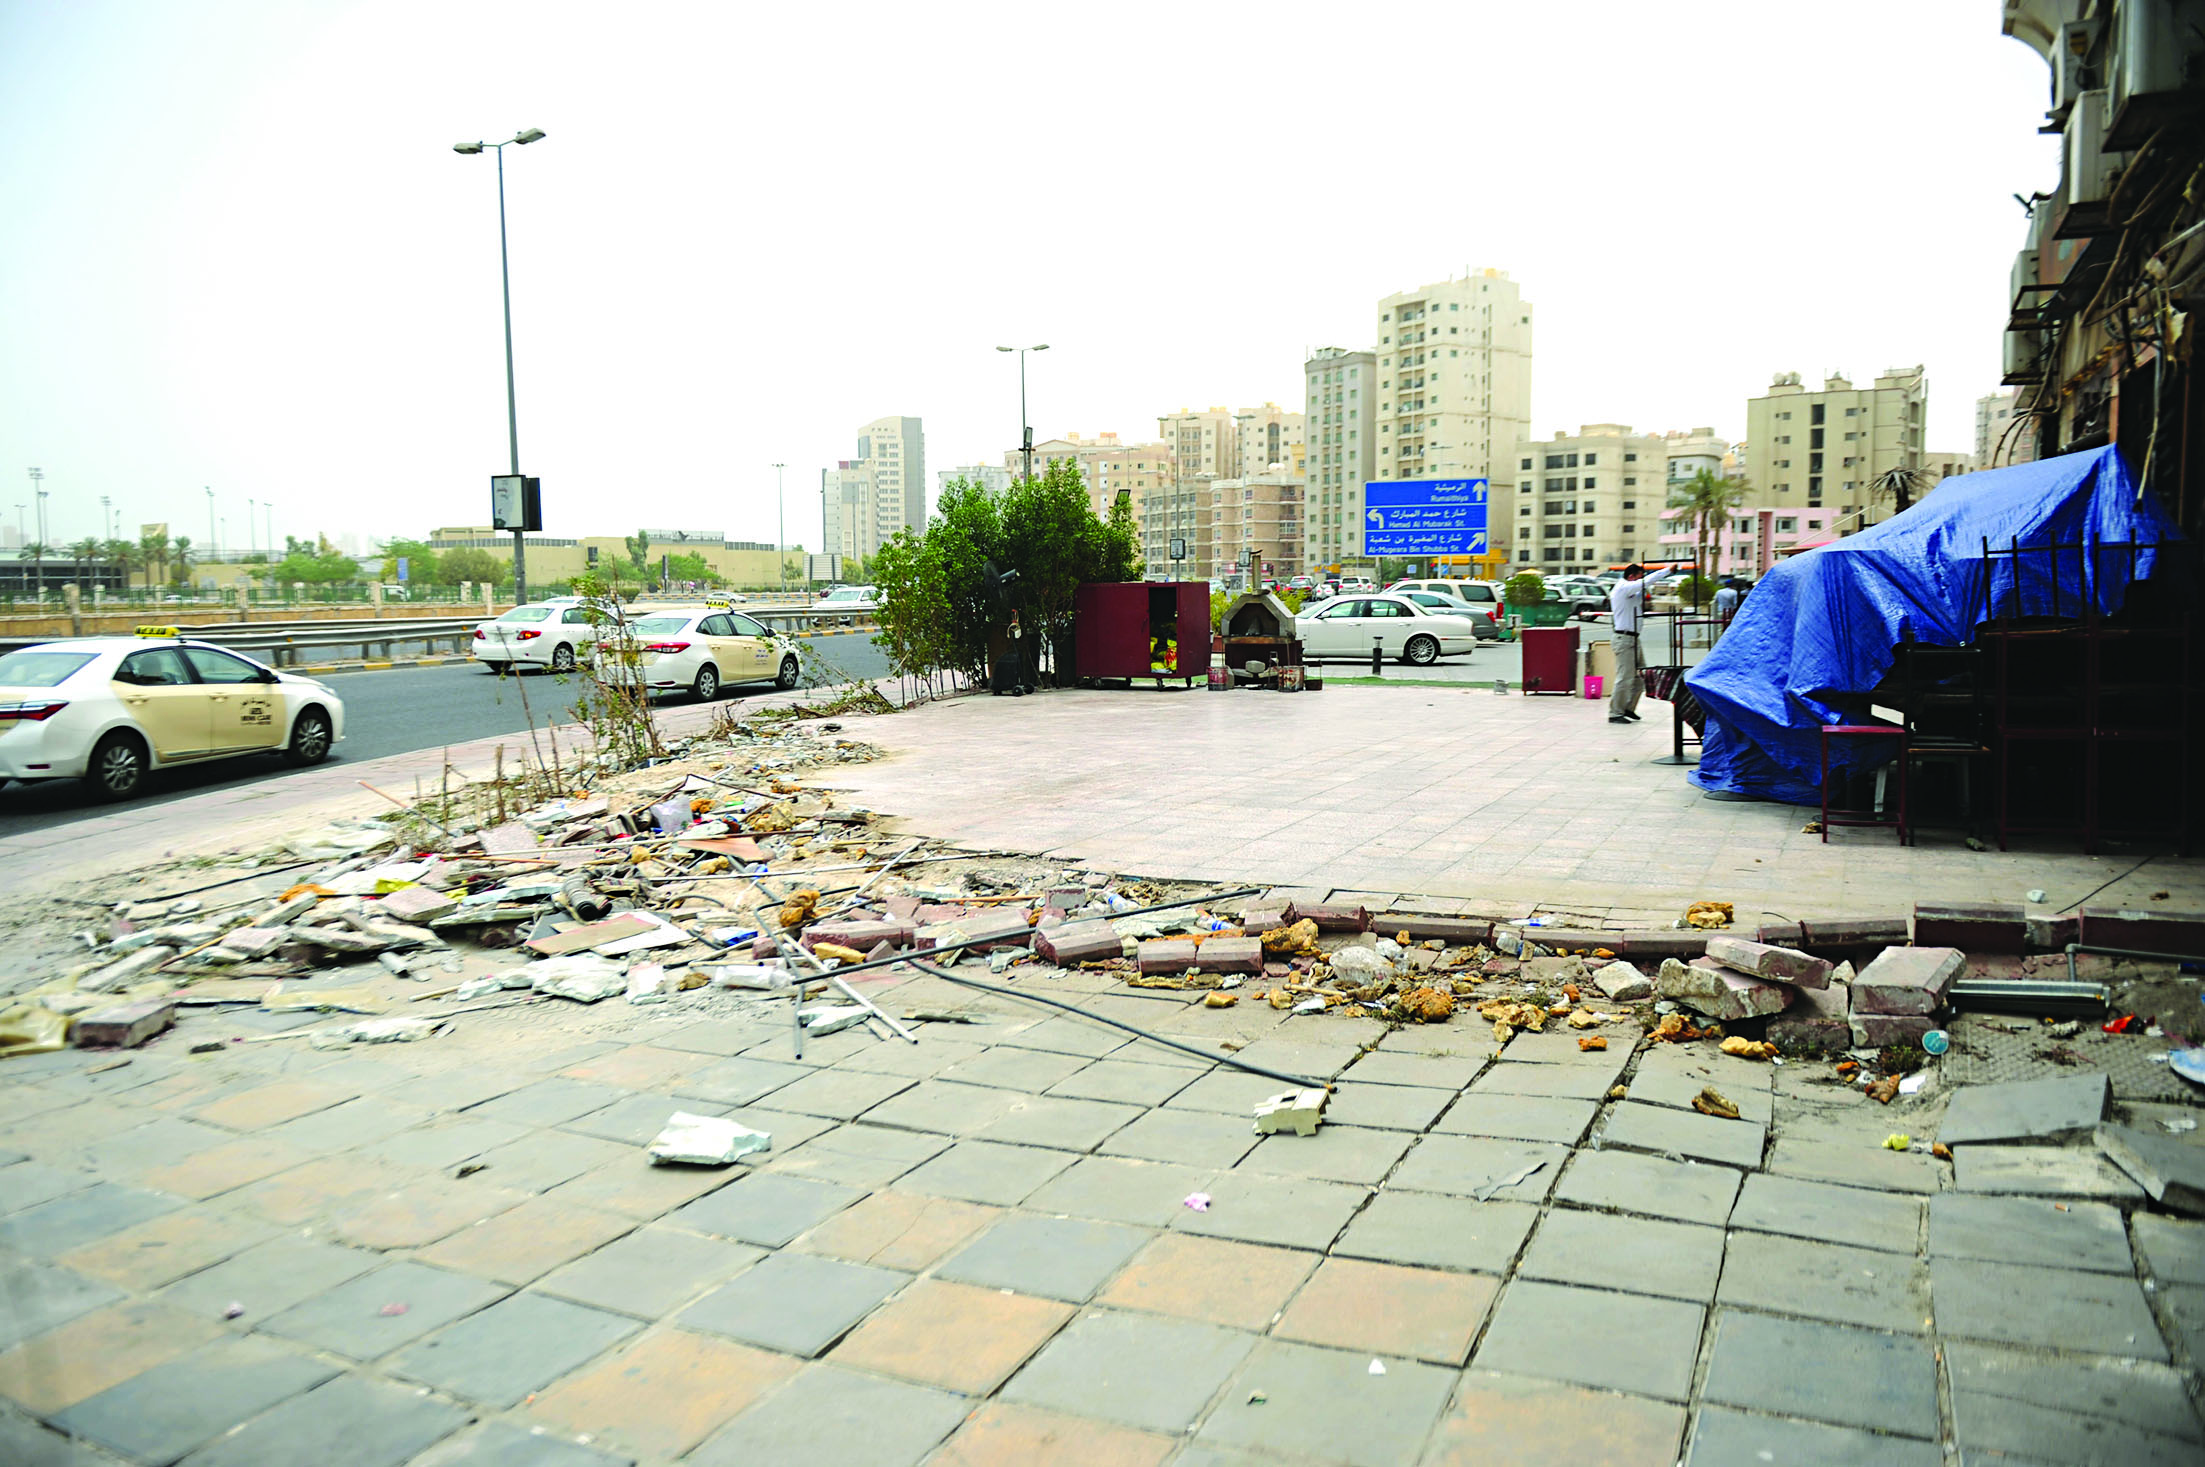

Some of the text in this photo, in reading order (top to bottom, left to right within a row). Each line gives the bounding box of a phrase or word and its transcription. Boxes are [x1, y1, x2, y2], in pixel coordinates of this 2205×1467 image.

[1390, 509, 1421, 519] المبارك
[1444, 508, 1467, 518] شارع
[1369, 534, 1463, 544] شارع المغيرة بن شعبة
[1409, 545, 1421, 553] Bin
